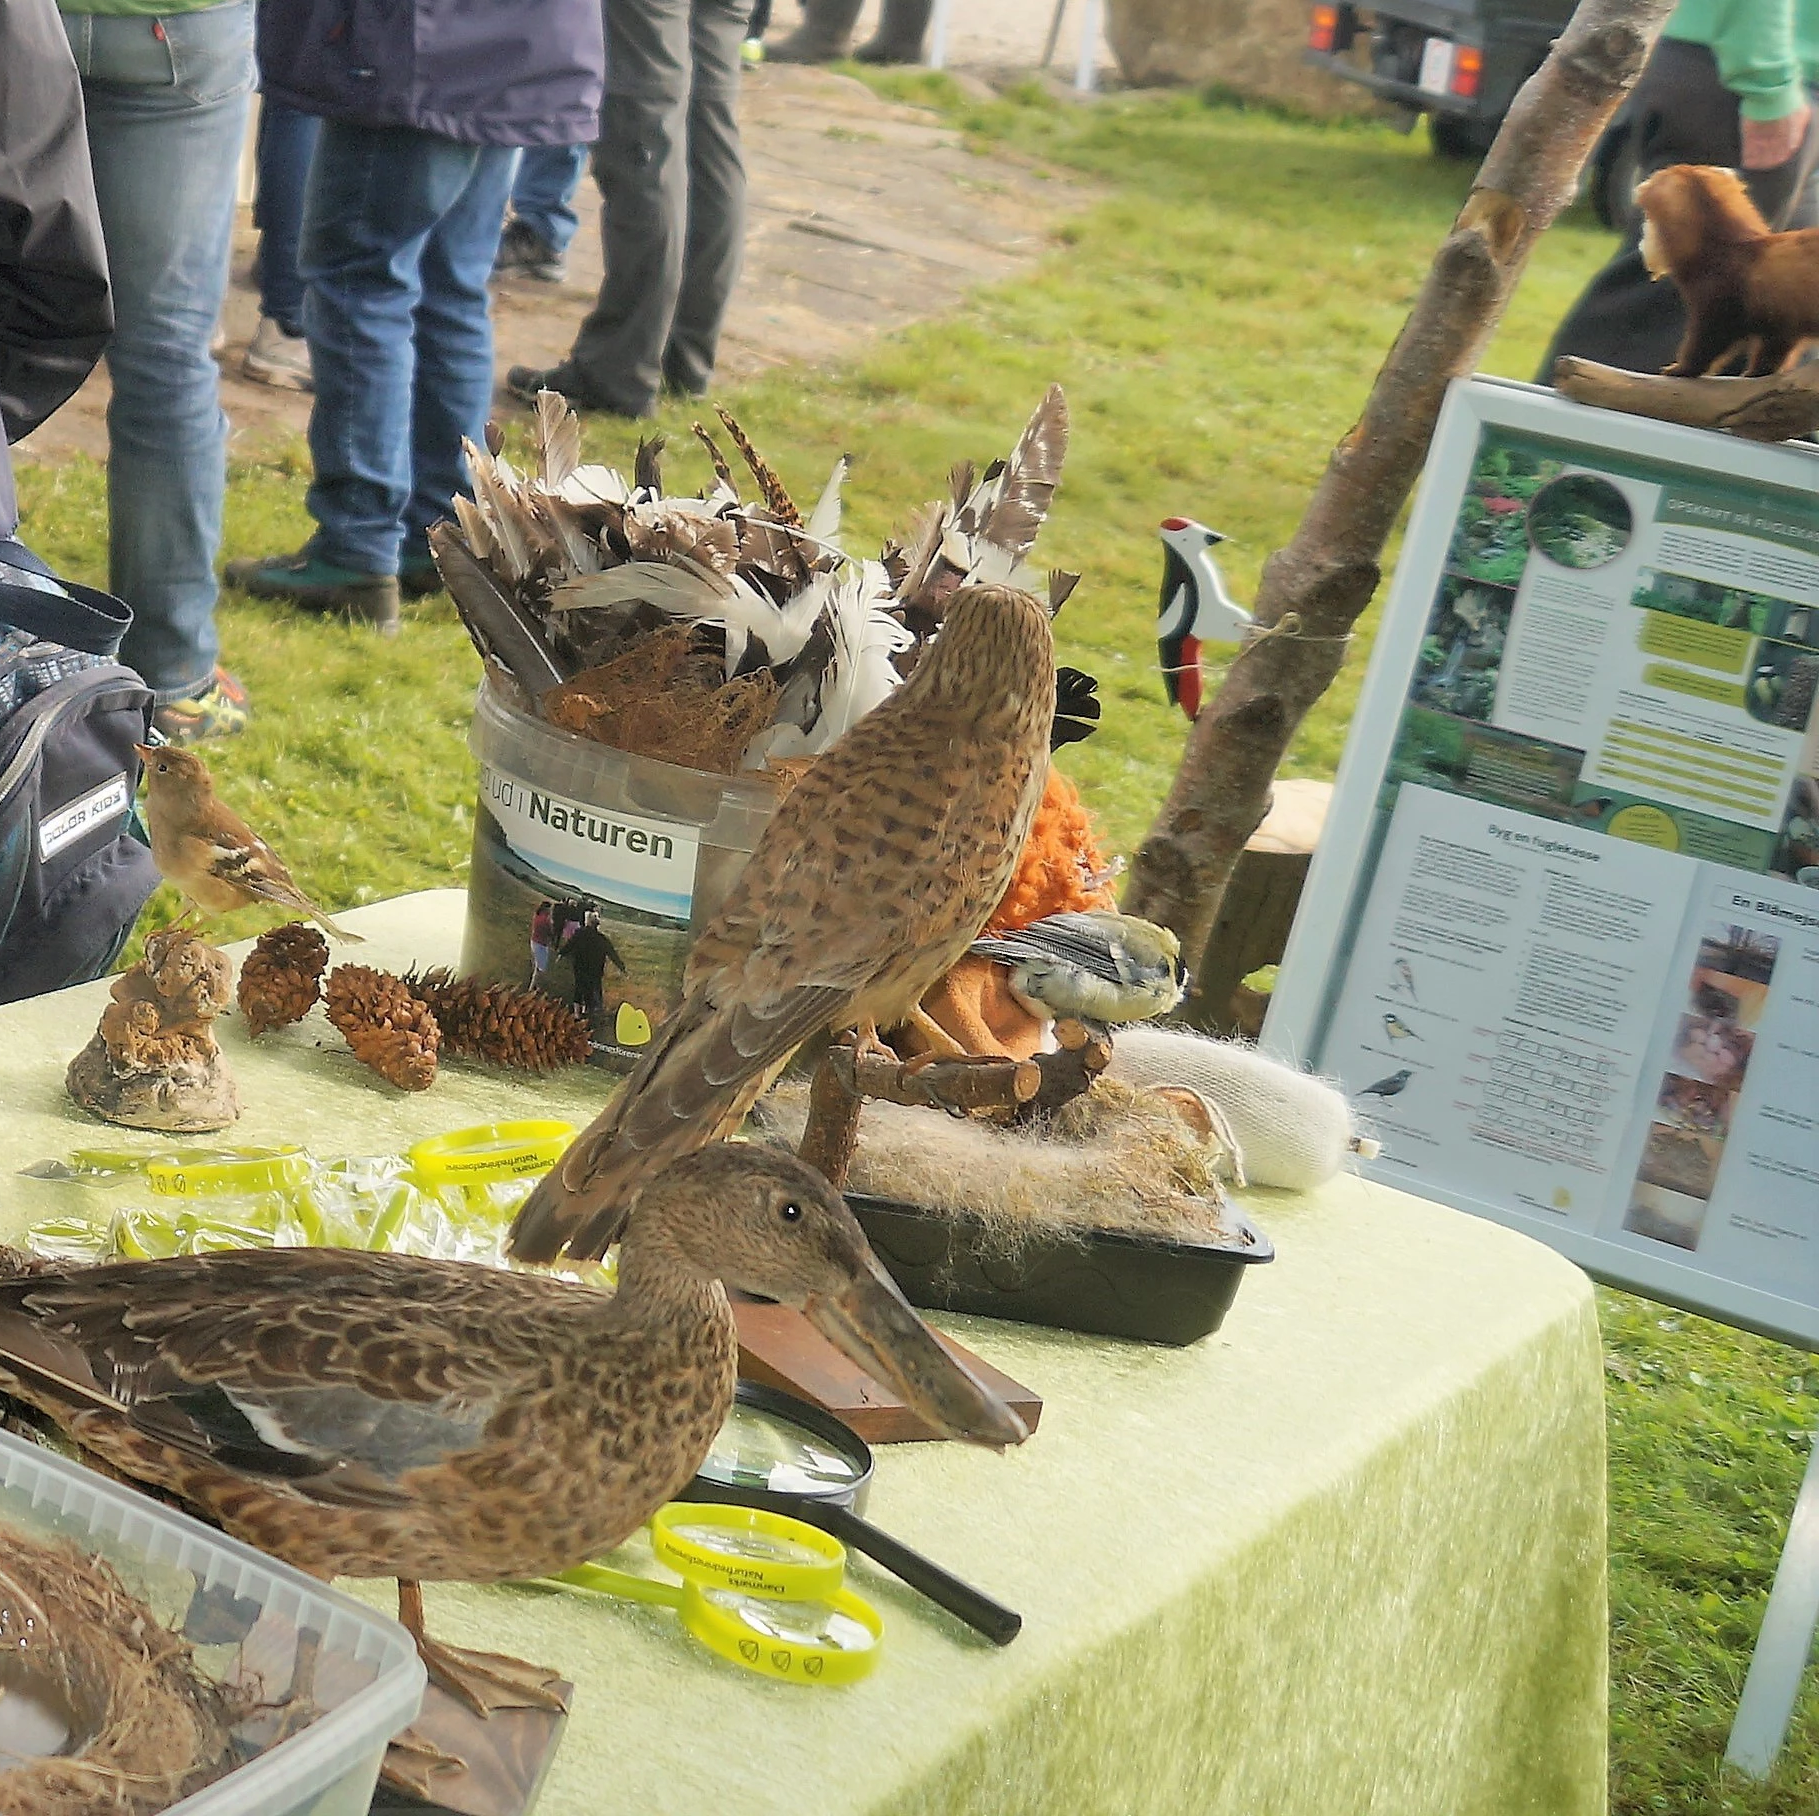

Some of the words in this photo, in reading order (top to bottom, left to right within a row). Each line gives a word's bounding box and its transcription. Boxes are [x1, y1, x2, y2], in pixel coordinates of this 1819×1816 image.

[44, 810, 86, 844] COLOR
[91, 790, 121, 817] KIDS
[529, 790, 674, 861] Naturen
[1488, 823, 1513, 841] Byg
[1514, 832, 1530, 844] en
[1531, 835, 1602, 862] fuglekasse
[1732, 894, 1751, 908] En
[1756, 900, 1819, 928] Blåmejs
[728, 1577, 787, 1594] Danmarks
